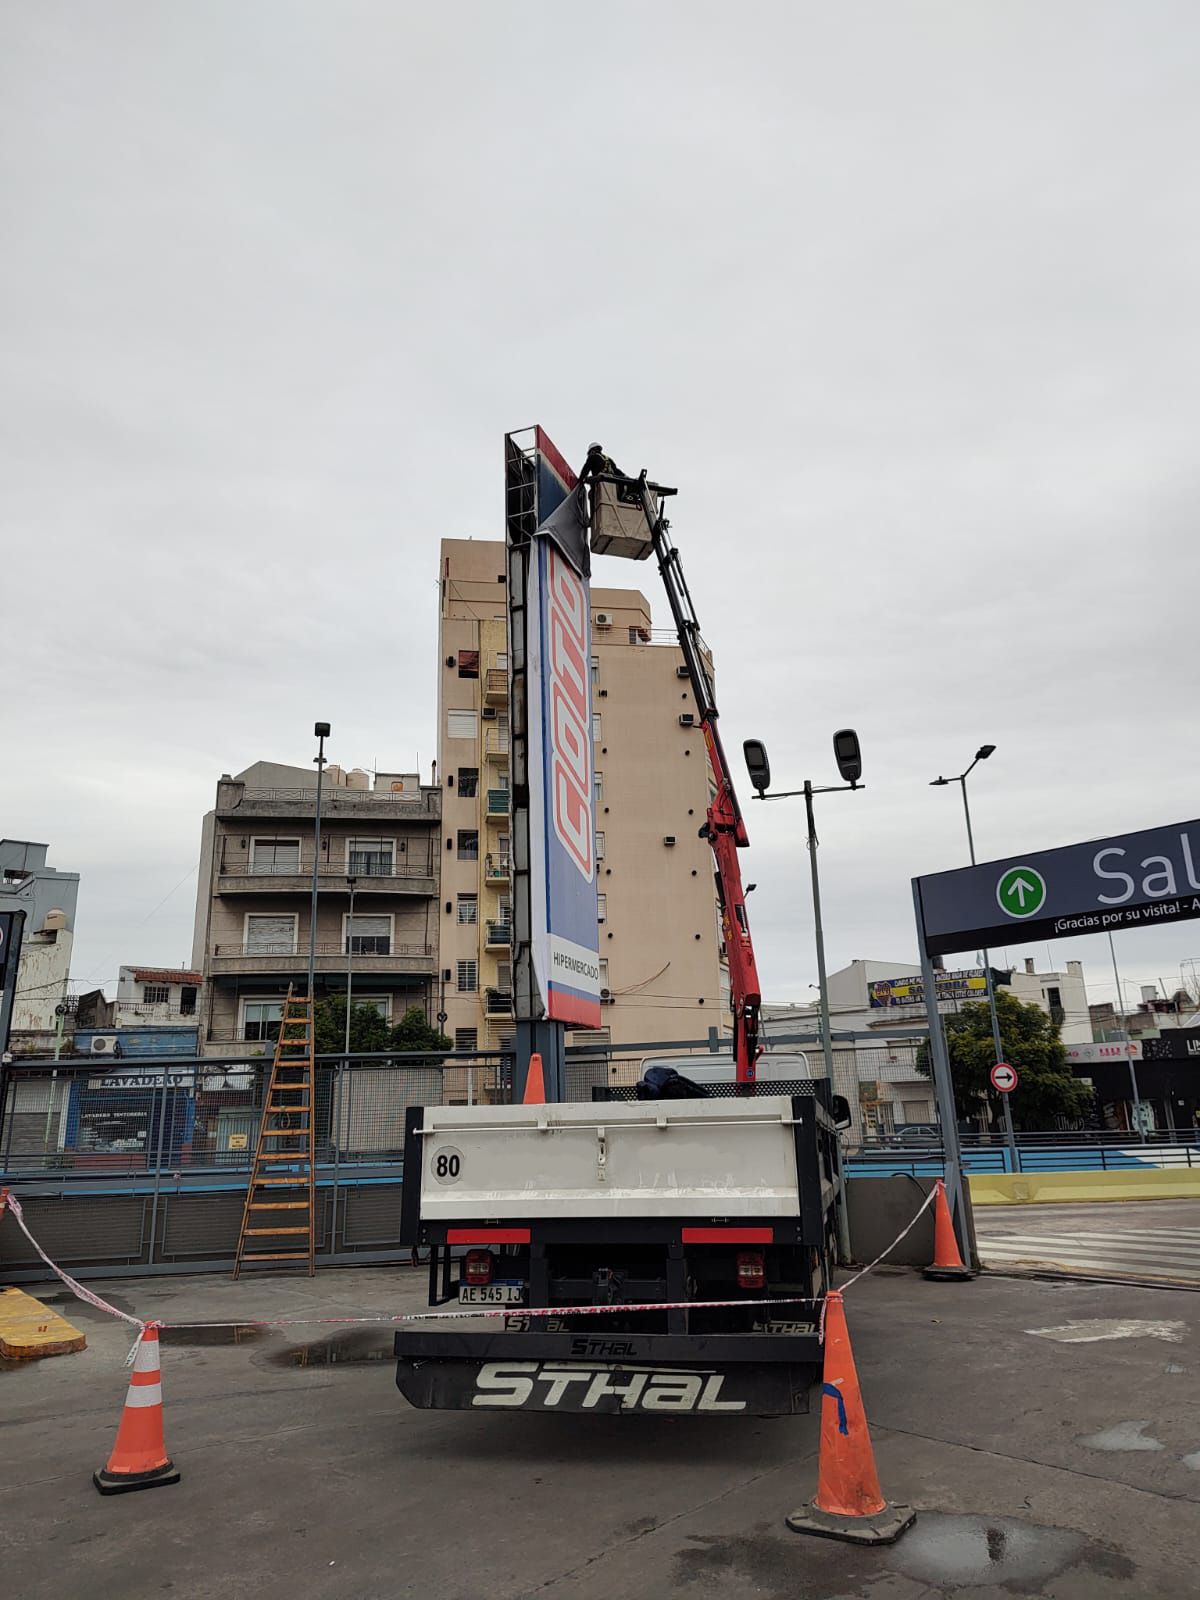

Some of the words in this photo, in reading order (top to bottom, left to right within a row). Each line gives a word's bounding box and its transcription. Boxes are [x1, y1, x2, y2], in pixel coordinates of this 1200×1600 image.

[1092, 833, 1200, 906] Sal
[1054, 915, 1100, 933] ¡Gracias
[1102, 911, 1123, 926] por
[1126, 908, 1141, 920] su
[1142, 901, 1180, 918] visita!
[553, 952, 599, 980] HIPERMERCADO
[436, 1154, 461, 1178] 80
[462, 1287, 476, 1301] AE
[480, 1287, 503, 1301] 545
